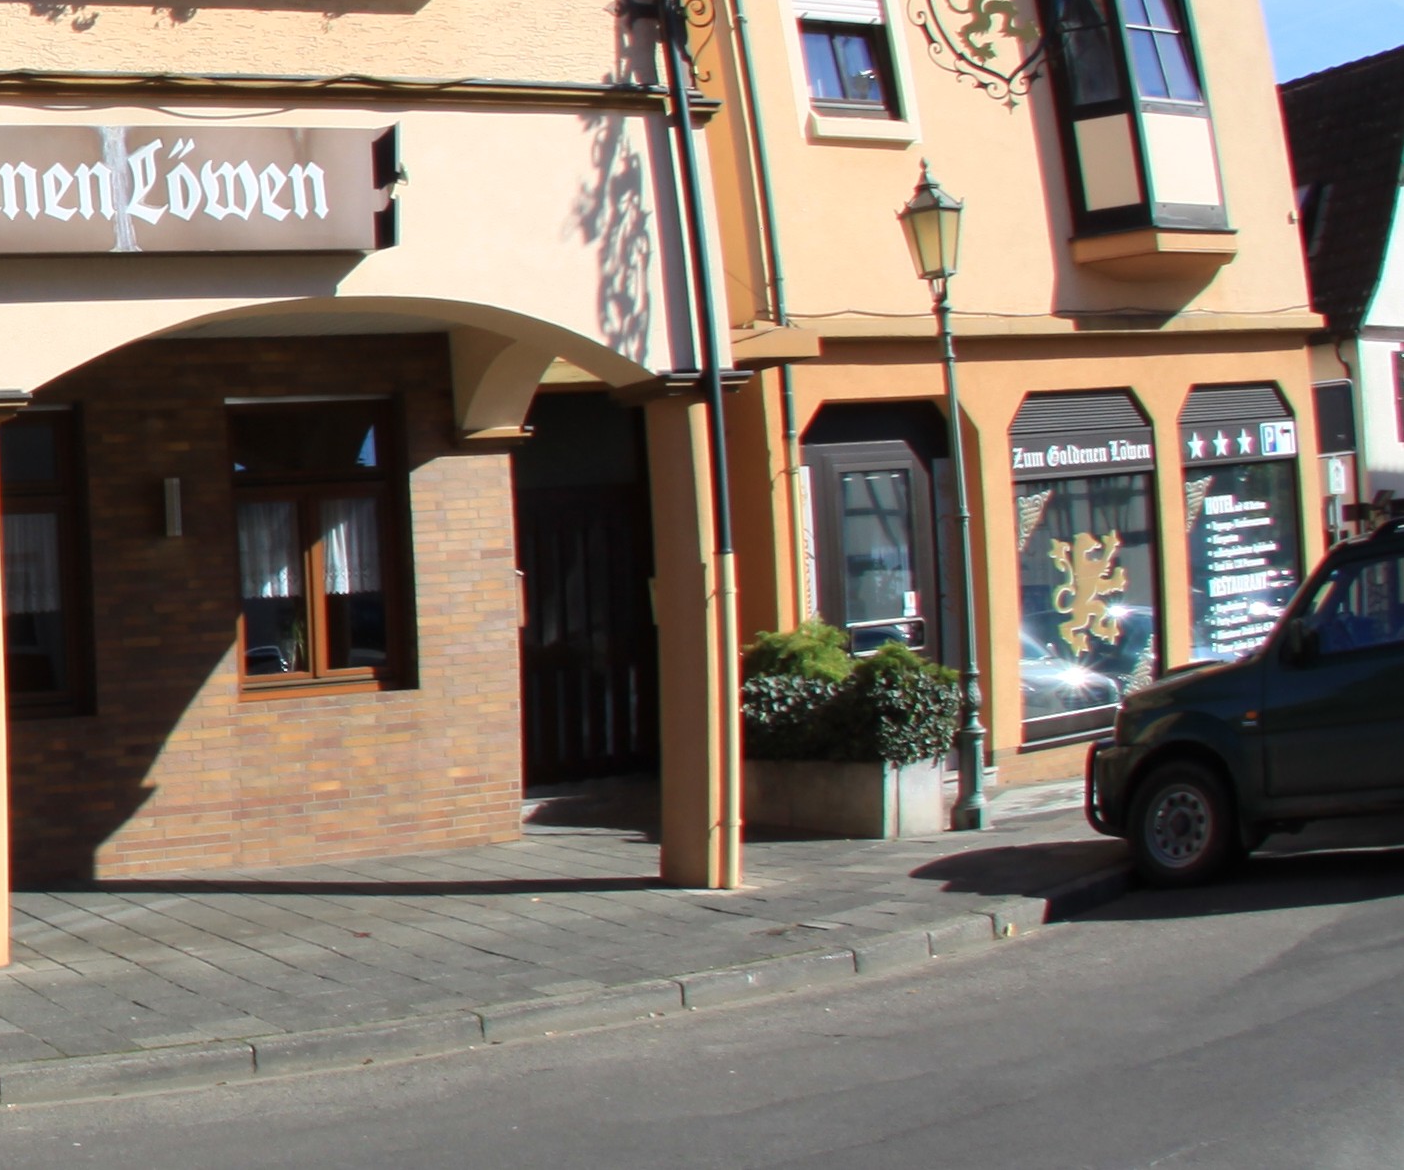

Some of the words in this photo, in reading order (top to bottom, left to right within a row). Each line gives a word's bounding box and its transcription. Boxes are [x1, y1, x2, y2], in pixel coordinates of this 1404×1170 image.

[125, 138, 331, 224] Löwen
[1012, 447, 1045, 469] Zum
[1047, 444, 1107, 467] Goldenen
[1108, 439, 1151, 462] Löwen
